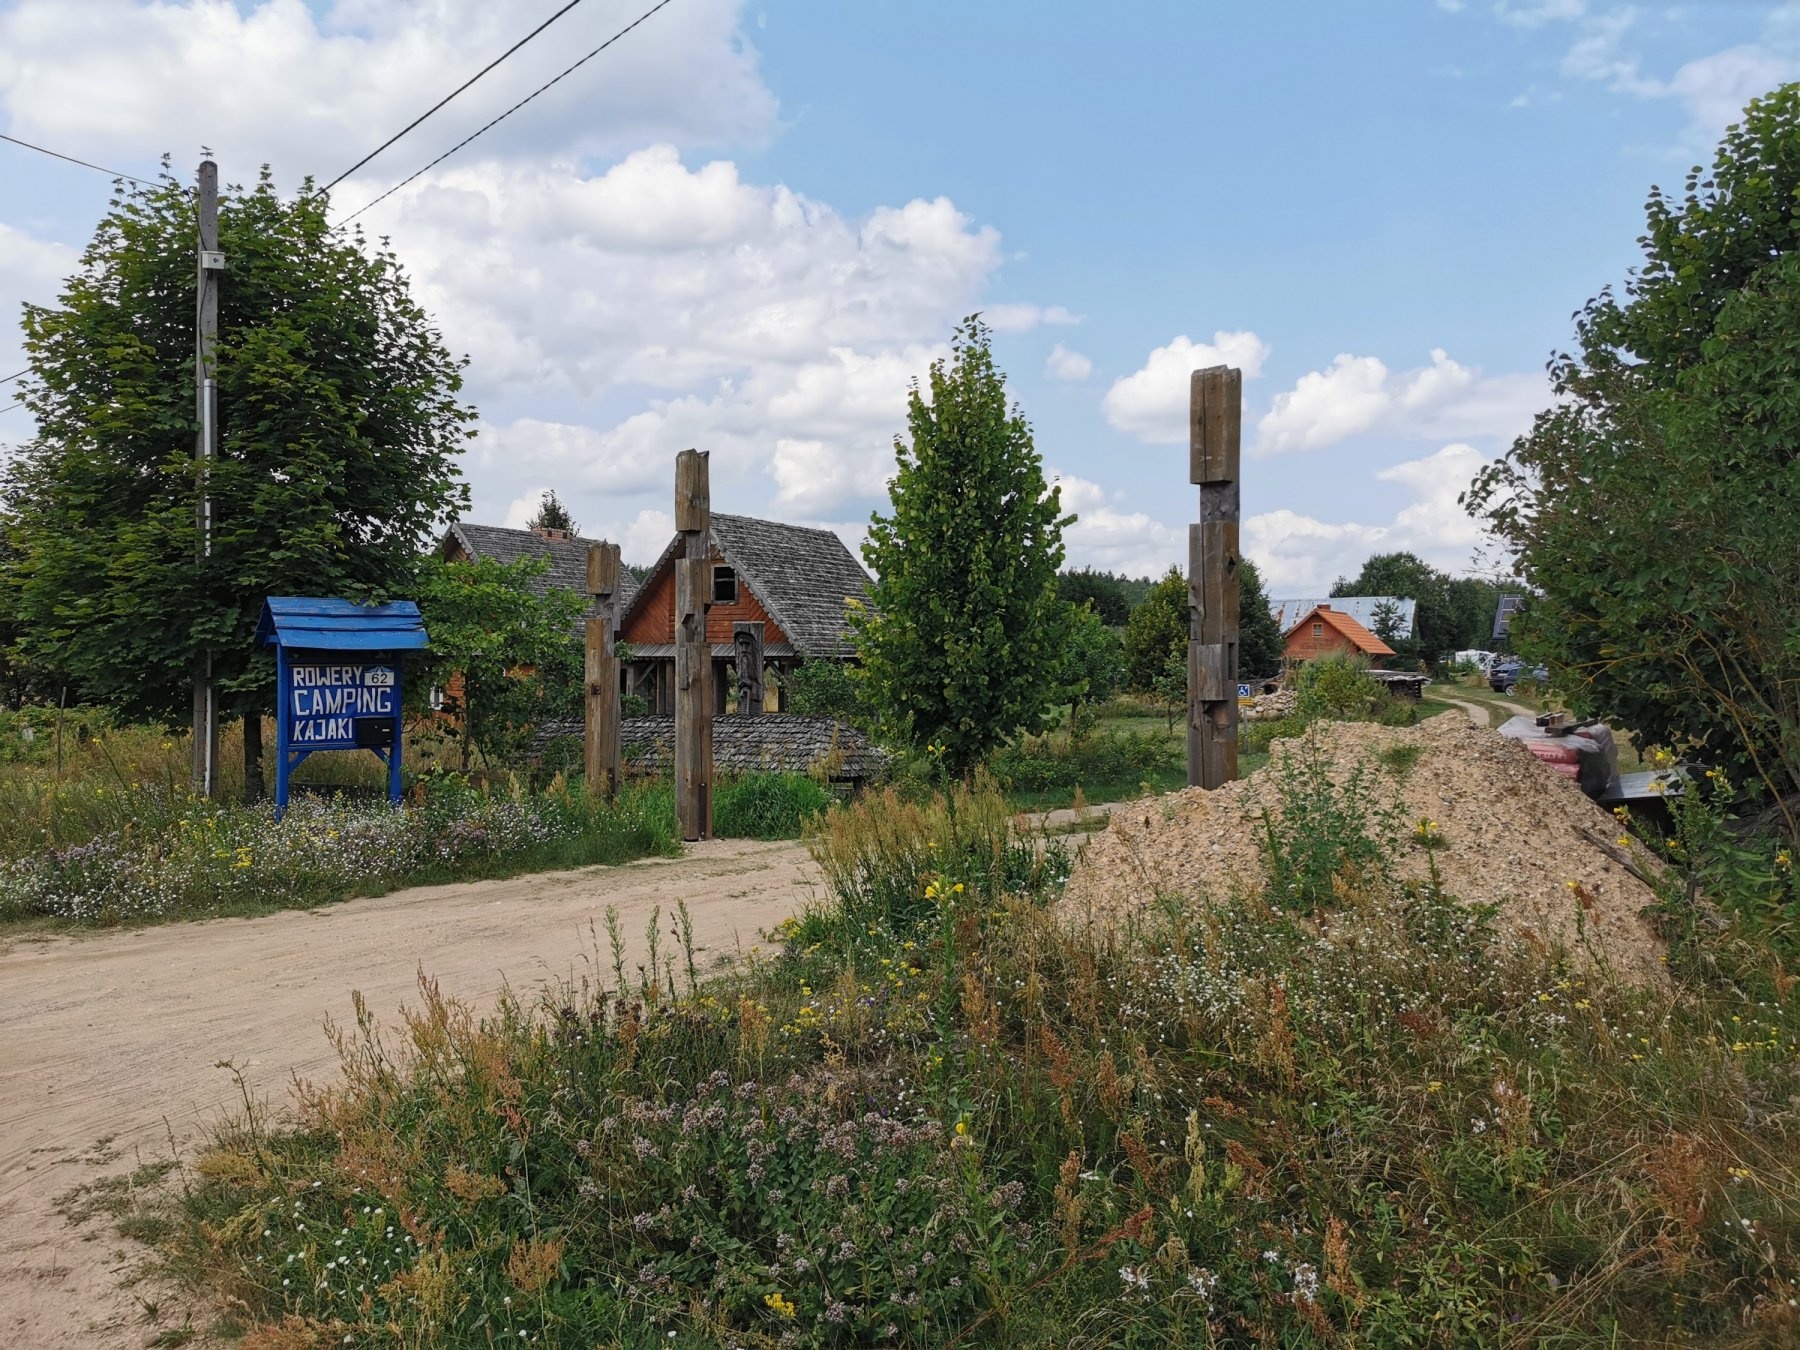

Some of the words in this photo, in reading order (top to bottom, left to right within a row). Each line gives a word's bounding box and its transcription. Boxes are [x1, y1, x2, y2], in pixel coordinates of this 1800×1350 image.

[293, 666, 362, 687] ROWERY
[371, 673, 388, 684] 62
[294, 687, 391, 716] CAMPING
[293, 718, 353, 741] KAJAKI
